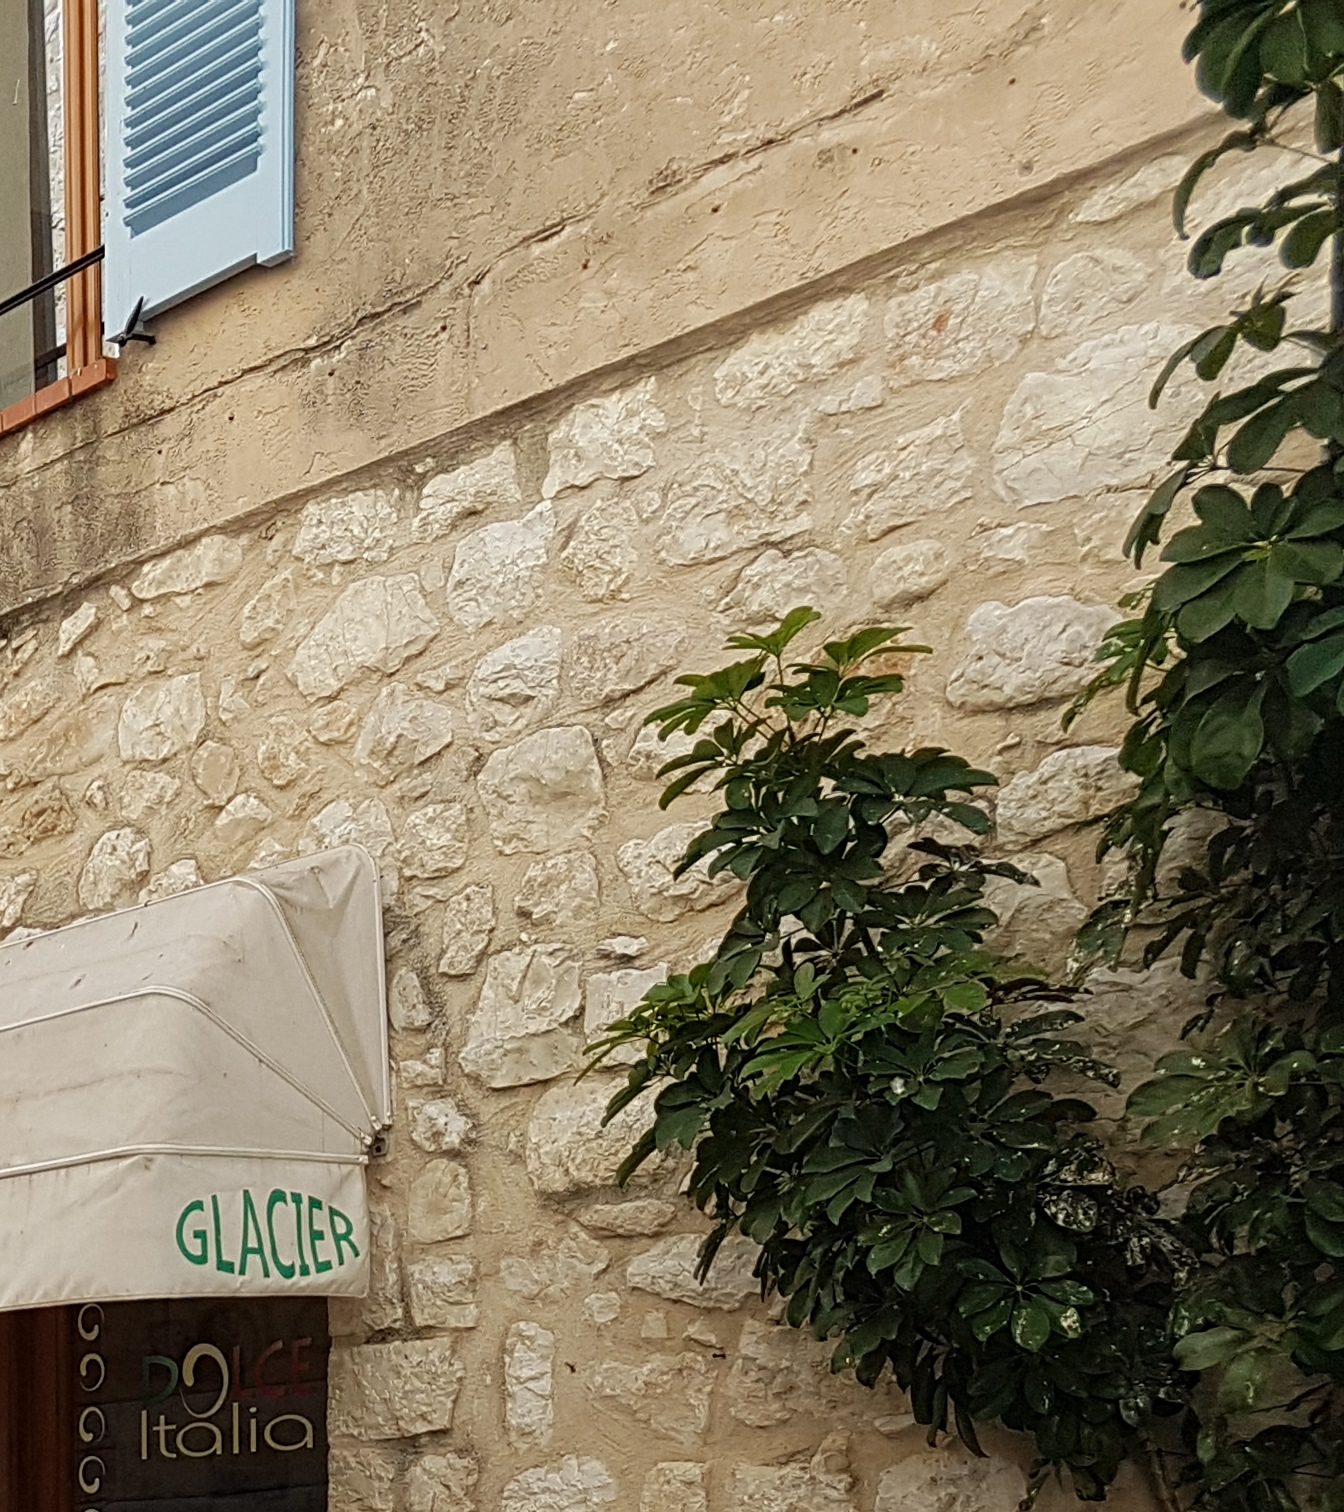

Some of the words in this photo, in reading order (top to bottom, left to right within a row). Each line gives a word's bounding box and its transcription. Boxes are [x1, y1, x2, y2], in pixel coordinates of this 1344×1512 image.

[174, 1186, 360, 1280] GLACIER
[142, 1337, 312, 1418] DOLCE
[140, 1402, 315, 1460] Italia
